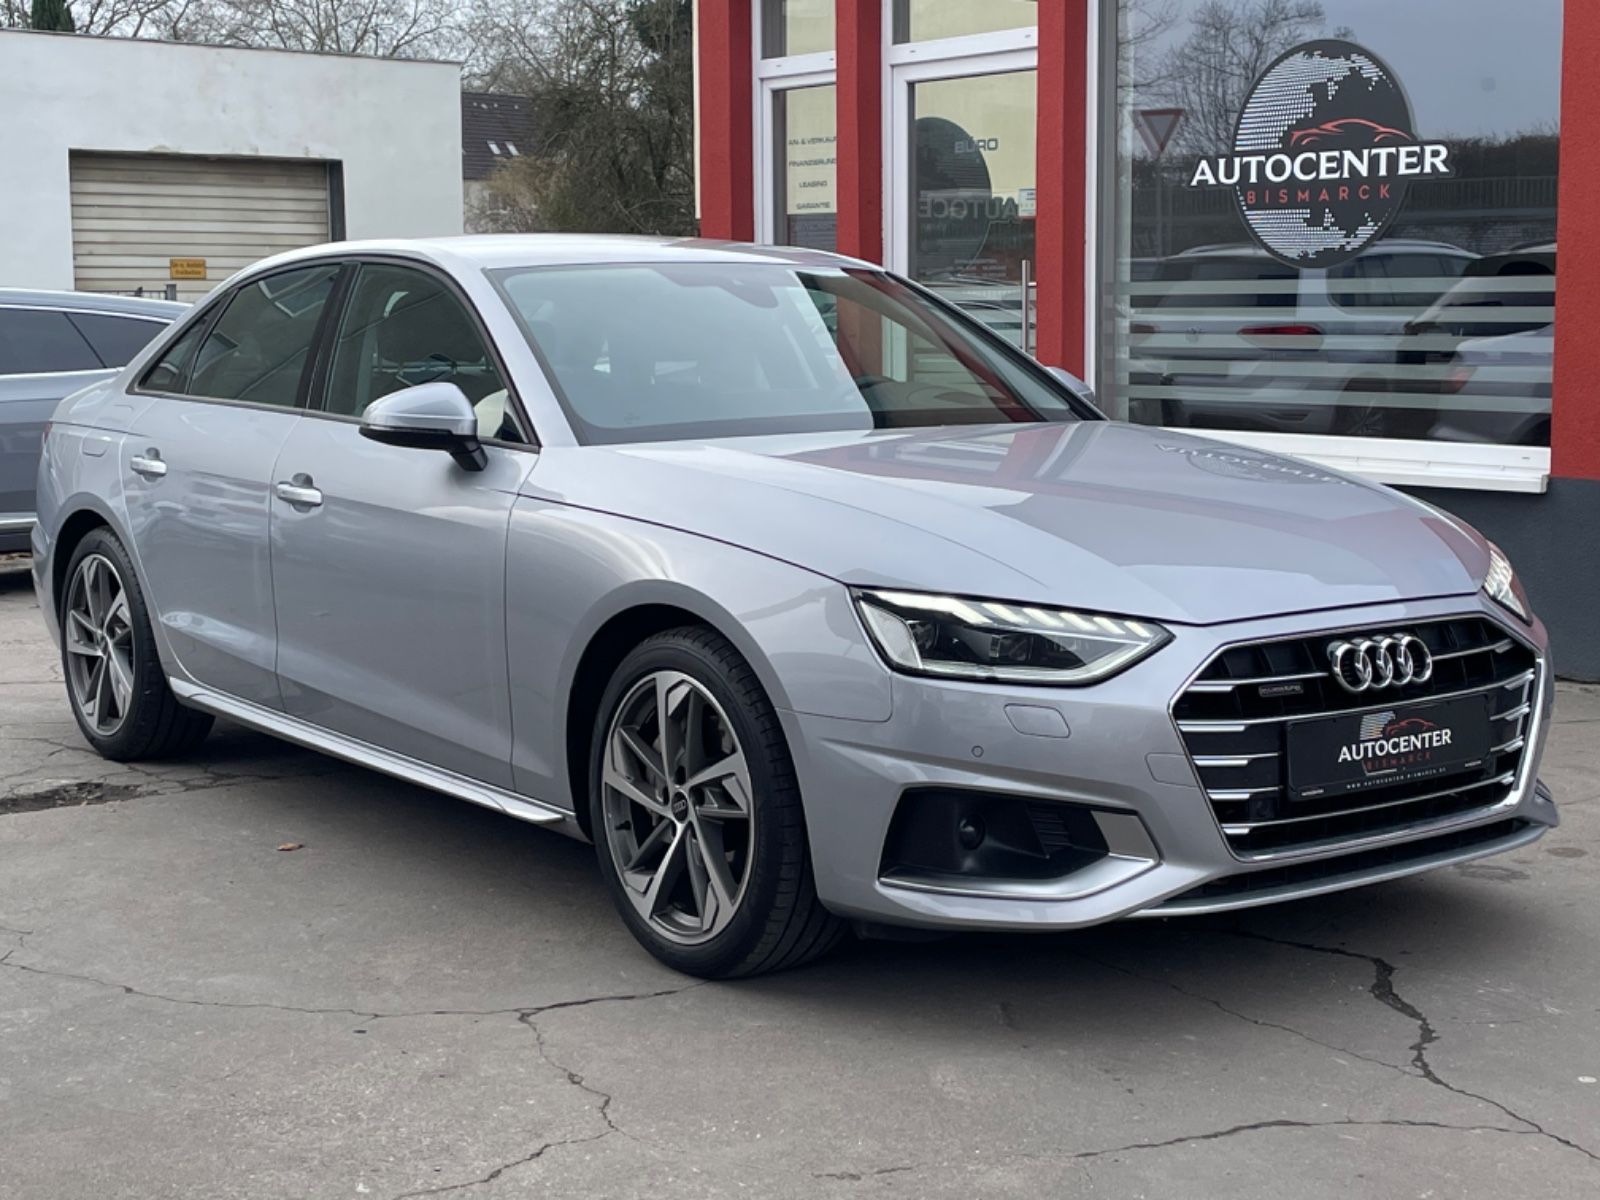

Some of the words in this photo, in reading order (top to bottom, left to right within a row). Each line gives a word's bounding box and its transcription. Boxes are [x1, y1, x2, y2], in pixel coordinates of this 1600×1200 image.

[1190, 144, 1450, 187] AUTOCENTER
[1246, 183, 1391, 205] BISMARCK
[1338, 728, 1453, 763] AUTOCENTER
